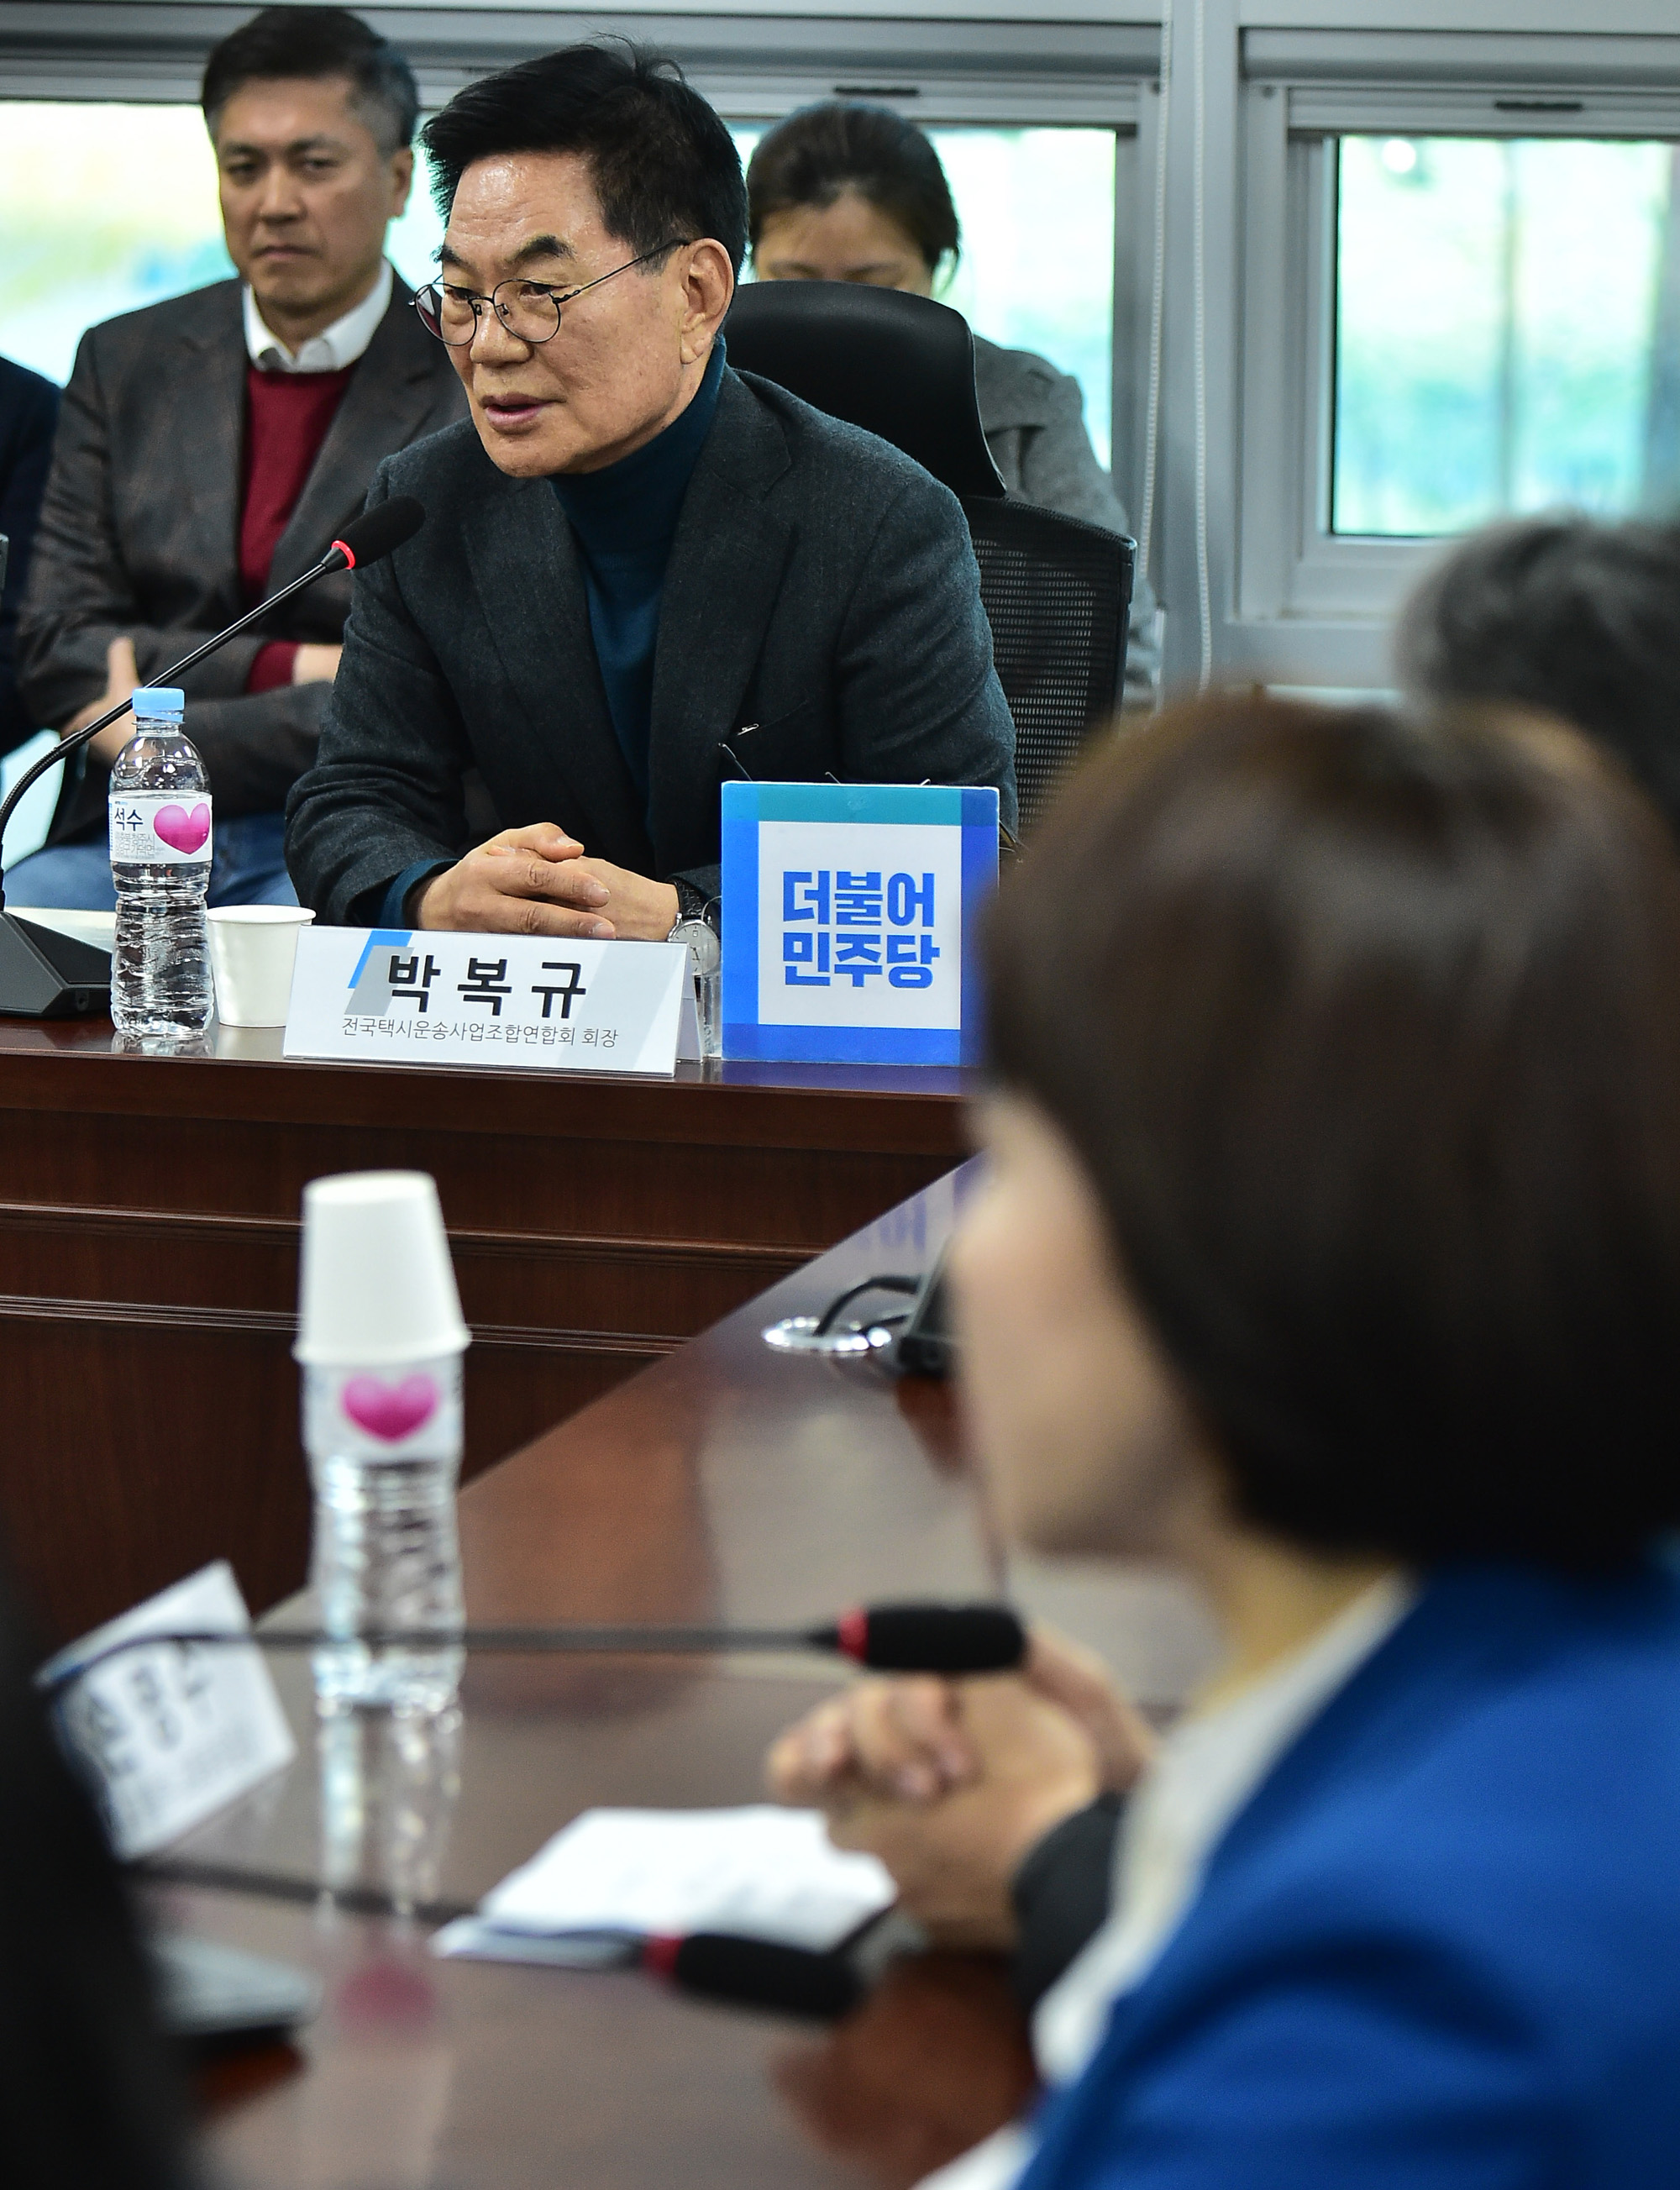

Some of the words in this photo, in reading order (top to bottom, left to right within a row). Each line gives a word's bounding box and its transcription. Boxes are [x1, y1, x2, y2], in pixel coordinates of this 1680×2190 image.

[114, 807, 144, 832] 석수
[783, 870, 935, 927] 더불어
[783, 932, 941, 989] 민주당
[342, 1016, 575, 1047] 전국택시운송사업조합연합회
[581, 1028, 619, 1048] 회장
